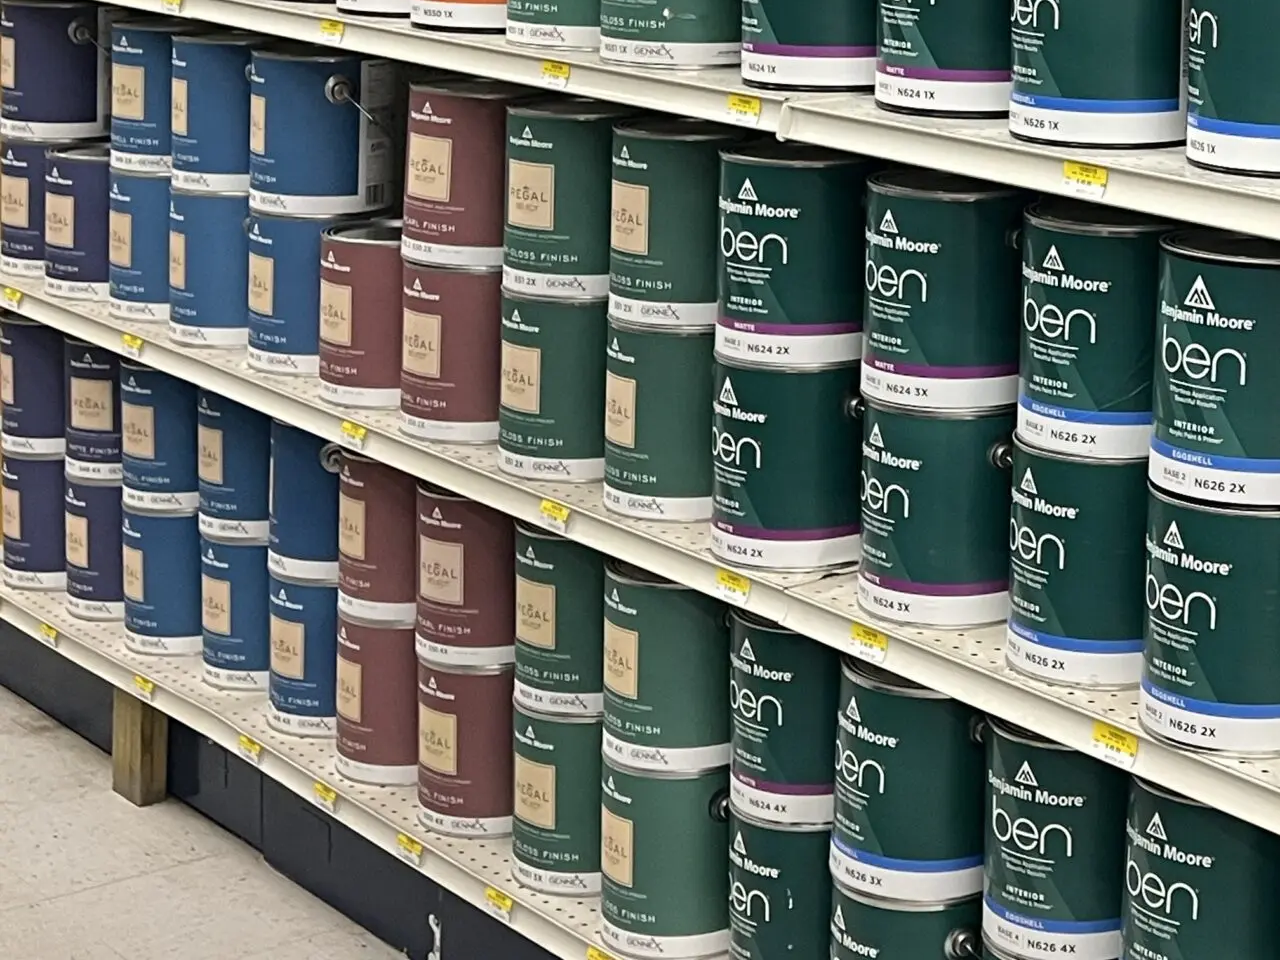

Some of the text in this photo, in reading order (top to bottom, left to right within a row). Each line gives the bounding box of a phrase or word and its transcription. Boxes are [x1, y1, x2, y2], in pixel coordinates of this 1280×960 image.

[755, 204, 798, 219] Moore
[422, 220, 456, 233] FINISH
[721, 216, 787, 265] ben
[541, 252, 578, 264] FINISH
[747, 344, 790, 355] N624 2X
[1050, 429, 1096, 445] N626 2X
[1172, 450, 1213, 466] EGGSHELL
[1195, 478, 1246, 494] N626 2X
[542, 669, 580, 682] FINISH
[1027, 939, 1076, 954] N626 4X
